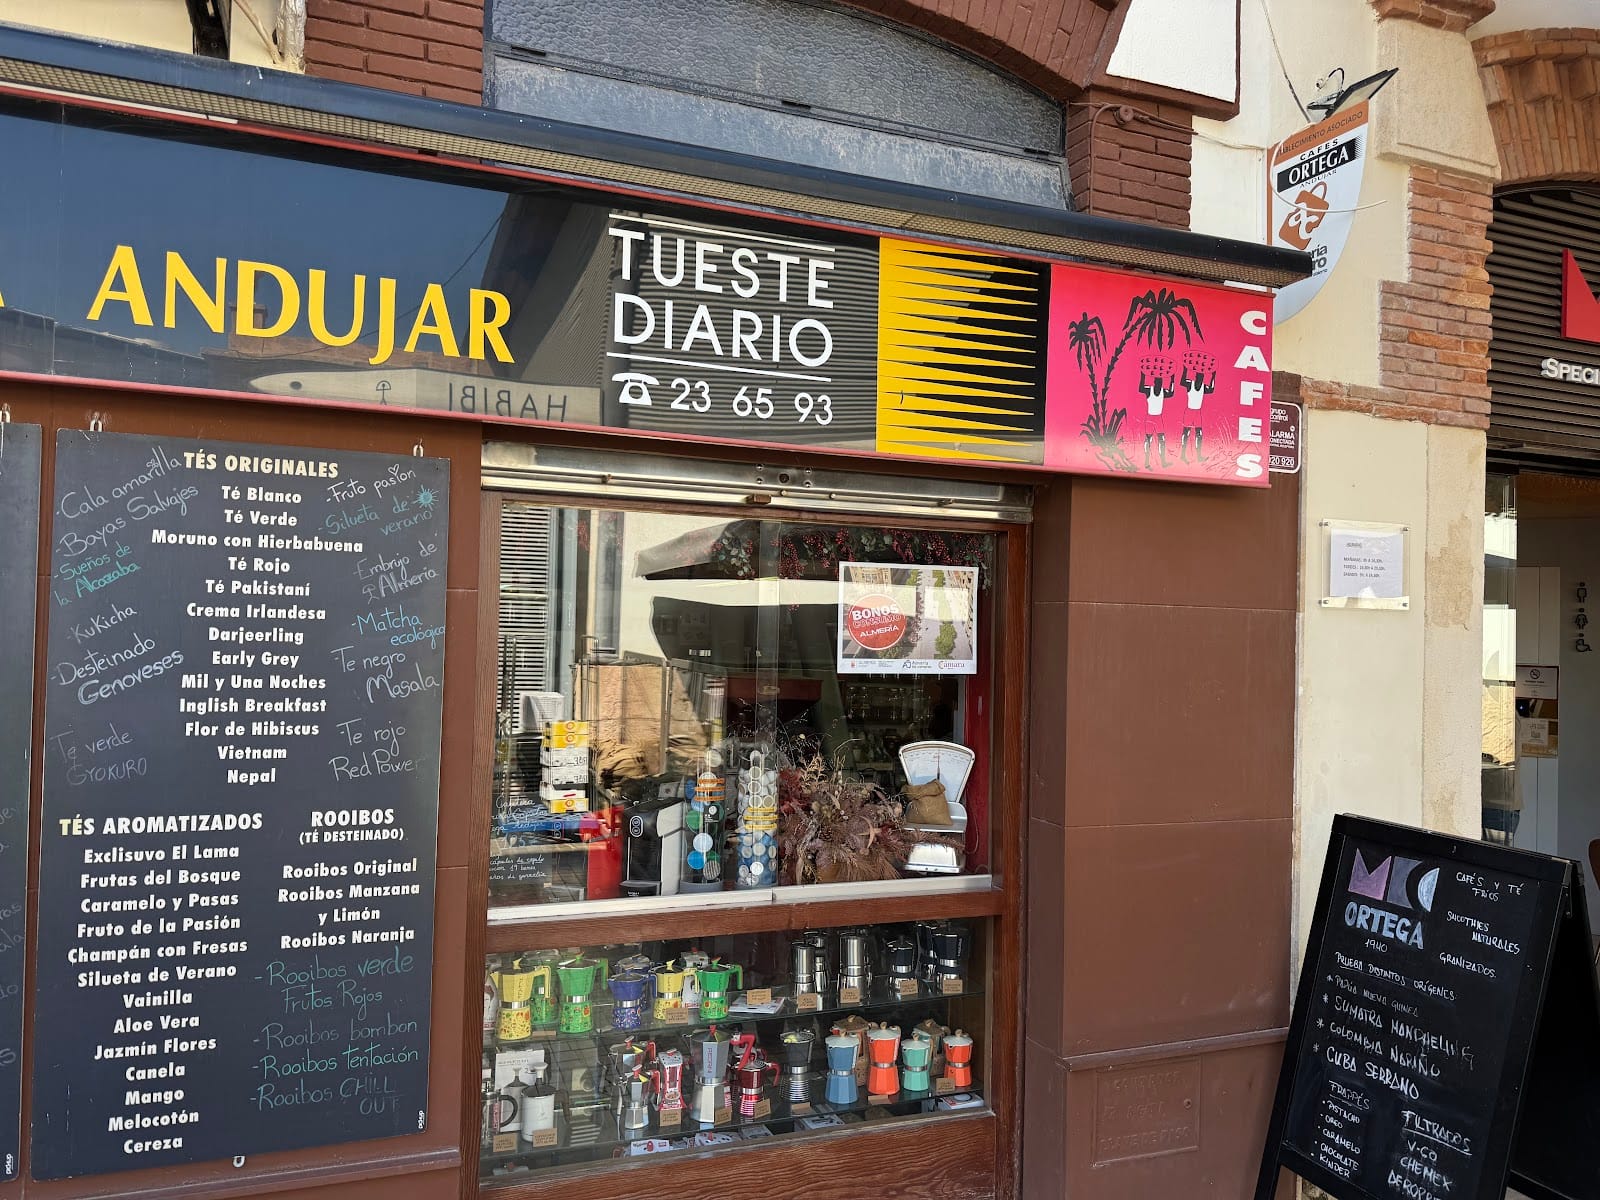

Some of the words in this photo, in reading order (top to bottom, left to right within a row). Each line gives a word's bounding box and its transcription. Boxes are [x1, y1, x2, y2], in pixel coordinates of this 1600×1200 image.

[1300, 139, 1338, 160] CAFES
[1289, 146, 1349, 184] ORTEGA
[608, 227, 835, 309] TUESTE
[87, 245, 516, 365] ANDUJAR
[614, 293, 834, 368] DIARIO
[670, 376, 712, 413] 23
[732, 384, 774, 419] 65
[794, 391, 833, 426] 93
[1234, 309, 1268, 479] CAFES
[183, 448, 217, 471] TÉS
[224, 455, 339, 478] ORIGINALES
[1282, 457, 1294, 466] 920
[61, 486, 109, 518] Cala
[112, 446, 181, 498] amarilla
[221, 484, 241, 502] Té
[247, 487, 302, 504] Blanco
[60, 517, 127, 556] Bayas
[127, 486, 199, 520] Salvajes
[224, 509, 245, 525] Té
[250, 511, 298, 527] Verde
[380, 510, 432, 535] verano
[151, 530, 218, 547] Moruno
[223, 534, 252, 548] con
[258, 534, 364, 553] Hierbabuena
[59, 554, 110, 580] Sueños
[116, 541, 132, 558] de
[228, 556, 248, 572] Té
[253, 558, 291, 574] Rojo
[205, 579, 225, 595] Té
[231, 579, 311, 597] Pakistaní
[186, 603, 240, 619] Crema
[246, 604, 327, 621] Irlandesa
[357, 604, 422, 635] Matcha
[852, 604, 899, 620] BONOS
[208, 627, 304, 645] Darjeerling
[56, 633, 156, 685] Desteinado
[212, 650, 255, 668] Early
[261, 652, 300, 669] Grey
[363, 652, 406, 679] negro
[78, 650, 184, 705] Genoveses
[182, 674, 209, 689] Mil
[215, 678, 226, 693] y
[230, 675, 265, 690] Una
[270, 675, 327, 691] Noches
[367, 662, 440, 703] Masala
[179, 698, 239, 715] Inglish
[245, 698, 327, 713] Breakfast
[86, 723, 134, 753] verde
[185, 721, 219, 738] Flor
[224, 722, 246, 737] de
[251, 721, 320, 738] Hibiscus
[374, 721, 406, 757] rojo
[217, 745, 288, 760] Vietnam
[227, 768, 277, 786] Nepal
[328, 752, 372, 781] Red
[59, 815, 95, 836] TÉS
[102, 813, 263, 835] AROMATIZADOS
[311, 809, 395, 828] ROOIBOS
[299, 830, 320, 846] (TÉ
[323, 827, 405, 844] DESTEINADO)
[84, 846, 167, 864] Exclisuvo
[172, 844, 188, 860] El
[194, 844, 240, 860] Lama
[80, 871, 139, 889] Frutas
[144, 870, 172, 885] del
[177, 868, 241, 886] Bosque
[282, 860, 348, 878] Rooibos
[353, 858, 418, 875] Original
[80, 895, 167, 914] Caramelo
[172, 896, 184, 910] y
[188, 892, 239, 907] Pasas
[278, 884, 344, 903] Rooibos
[348, 882, 420, 899] Manzana
[77, 921, 125, 939] Fruto
[131, 919, 153, 935] de
[158, 918, 177, 933] la
[182, 915, 241, 932] Pasión
[318, 911, 328, 925] y
[333, 907, 380, 923] Limón
[1344, 902, 1424, 950] ORTEGA
[280, 931, 347, 949] Rooibos
[352, 927, 415, 944] Naranja
[1364, 938, 1388, 953] 1940
[68, 946, 152, 965] Champán
[157, 944, 187, 957] con
[192, 939, 248, 955] Fresas
[77, 969, 141, 988] Silueta
[147, 967, 170, 982] de
[175, 964, 237, 980] Verano
[266, 954, 347, 985] Rooibos
[358, 945, 414, 977] verde
[1335, 951, 1363, 971] PRUEBA
[1368, 963, 1406, 986] DISTINTOS
[123, 990, 193, 1009] Vainilla
[337, 979, 383, 1021] Rojos
[1335, 995, 1382, 1028] SUMATRA
[113, 1017, 154, 1034] Aloe
[159, 1014, 200, 1030] Vera
[262, 1019, 339, 1050] Rooibos
[351, 1012, 417, 1040] bombon
[94, 1040, 158, 1060] Jazmín
[163, 1036, 217, 1053] Flores
[125, 1063, 186, 1081] Canela
[260, 1048, 337, 1079] Rooibos
[1326, 1046, 1356, 1072] CUBA
[1365, 1062, 1419, 1100] SERRANO
[125, 1086, 185, 1106] Mango
[257, 1077, 333, 1111] Rooibos
[107, 1110, 199, 1132] Melocotón
[123, 1134, 183, 1153] Cereza
[1322, 1128, 1360, 1154] CARAMELO
[1319, 1153, 1351, 1178] KINDER
[1400, 1157, 1452, 1192] CHEMEX
